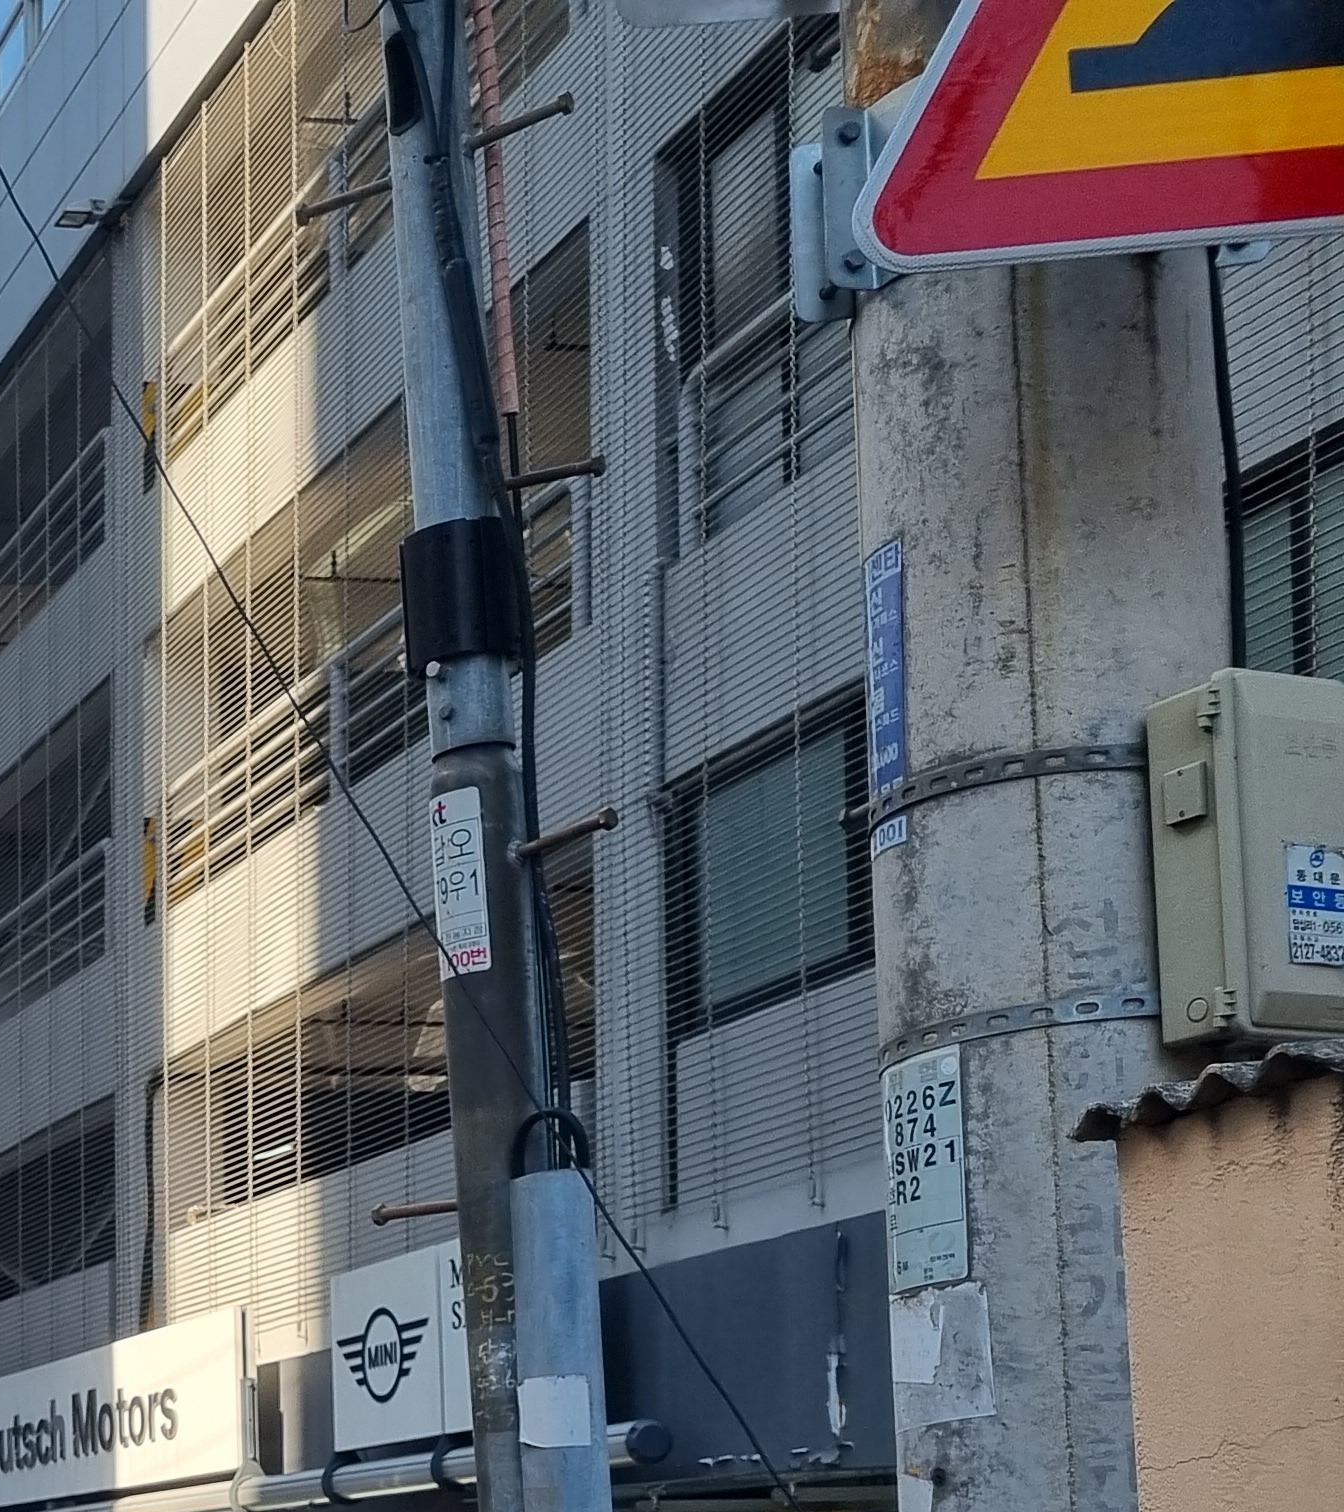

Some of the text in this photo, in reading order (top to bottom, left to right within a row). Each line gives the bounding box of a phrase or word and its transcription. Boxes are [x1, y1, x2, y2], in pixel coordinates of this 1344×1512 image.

[896, 1176, 922, 1206] R2
[367, 1341, 398, 1370] MINI
[71, 1387, 178, 1458] Motors
